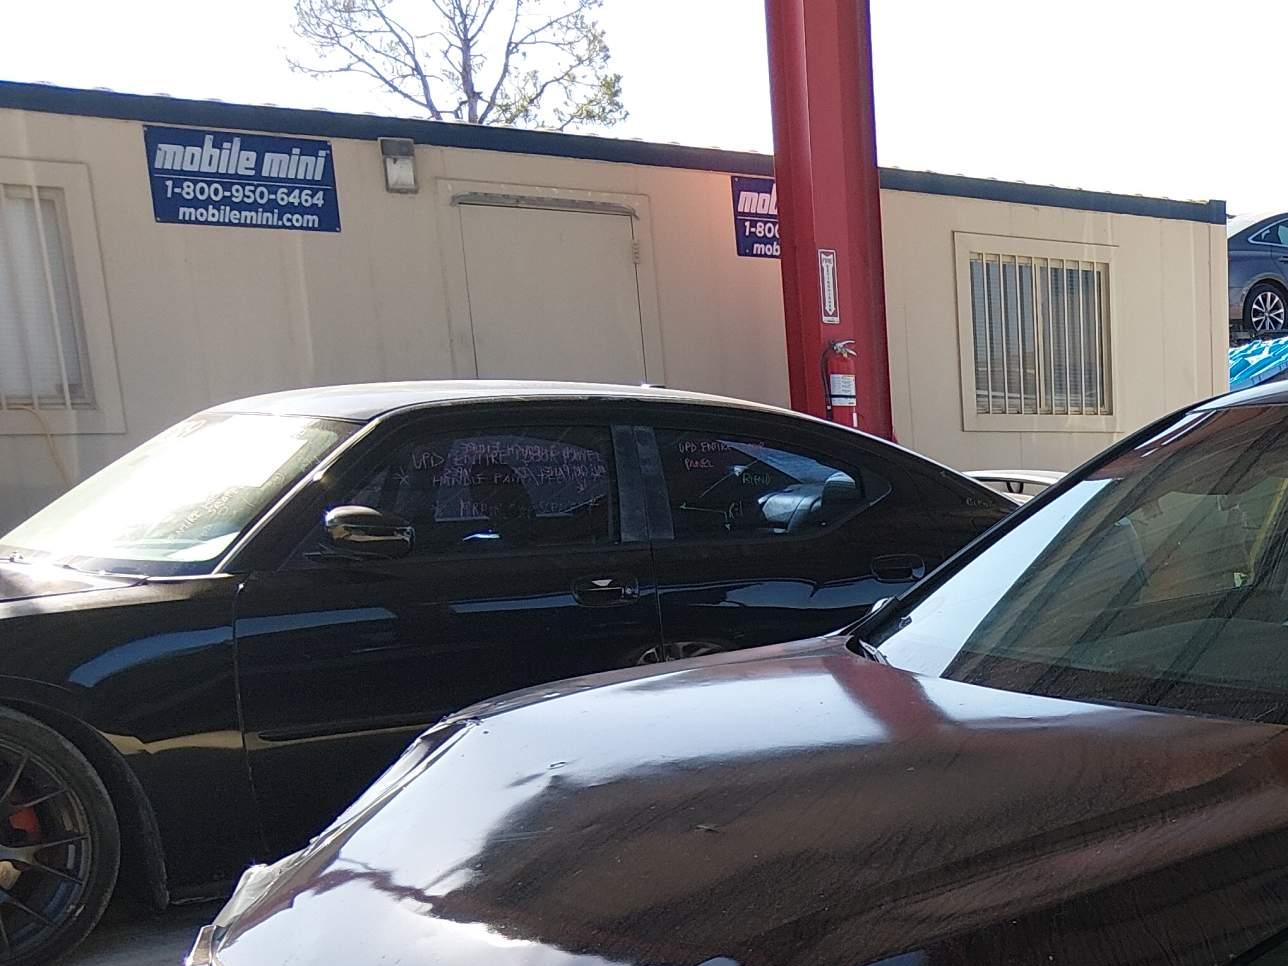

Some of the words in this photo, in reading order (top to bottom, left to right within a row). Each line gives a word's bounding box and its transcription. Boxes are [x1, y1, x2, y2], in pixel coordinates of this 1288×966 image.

[154, 135, 257, 176] mobile
[261, 148, 326, 181] mini
[164, 180, 325, 208] 1-800-950-6464
[178, 205, 319, 228] mobilemini.com
